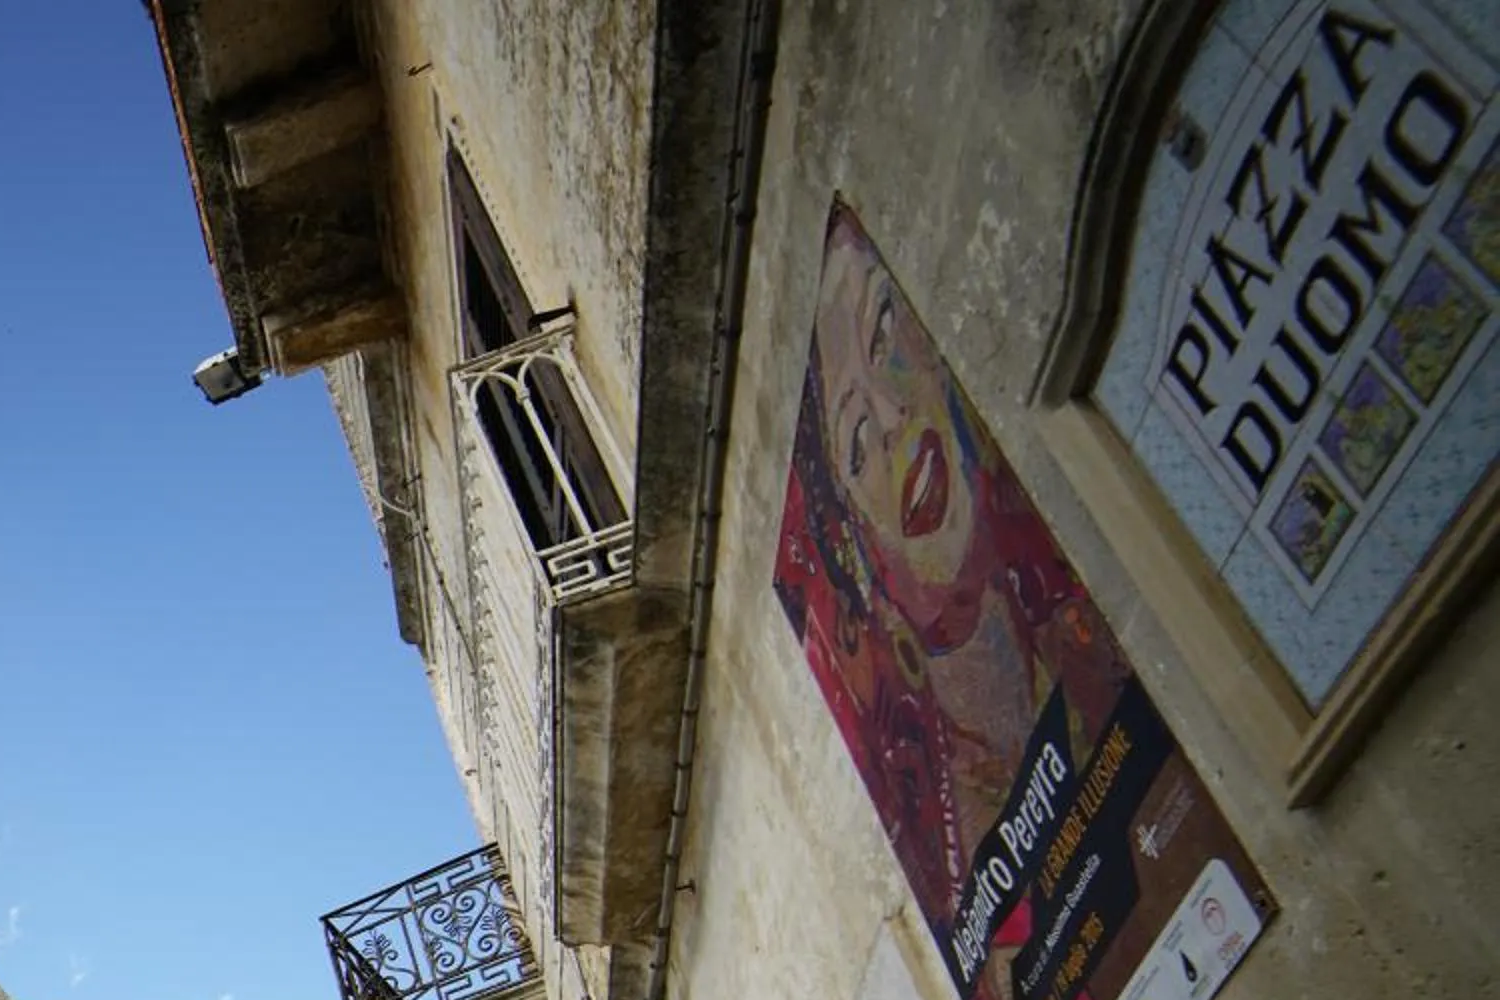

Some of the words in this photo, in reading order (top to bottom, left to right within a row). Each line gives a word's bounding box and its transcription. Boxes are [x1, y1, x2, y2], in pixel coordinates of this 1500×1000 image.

[1161, 8, 1396, 416] PIAZZA
[1220, 69, 1470, 494] DUOMO
[952, 855, 1013, 984] Alejandro
[999, 742, 1067, 869] Pereyra
[1046, 805, 1087, 879] GRANDE
[1077, 721, 1132, 821] ILLUSIONE
